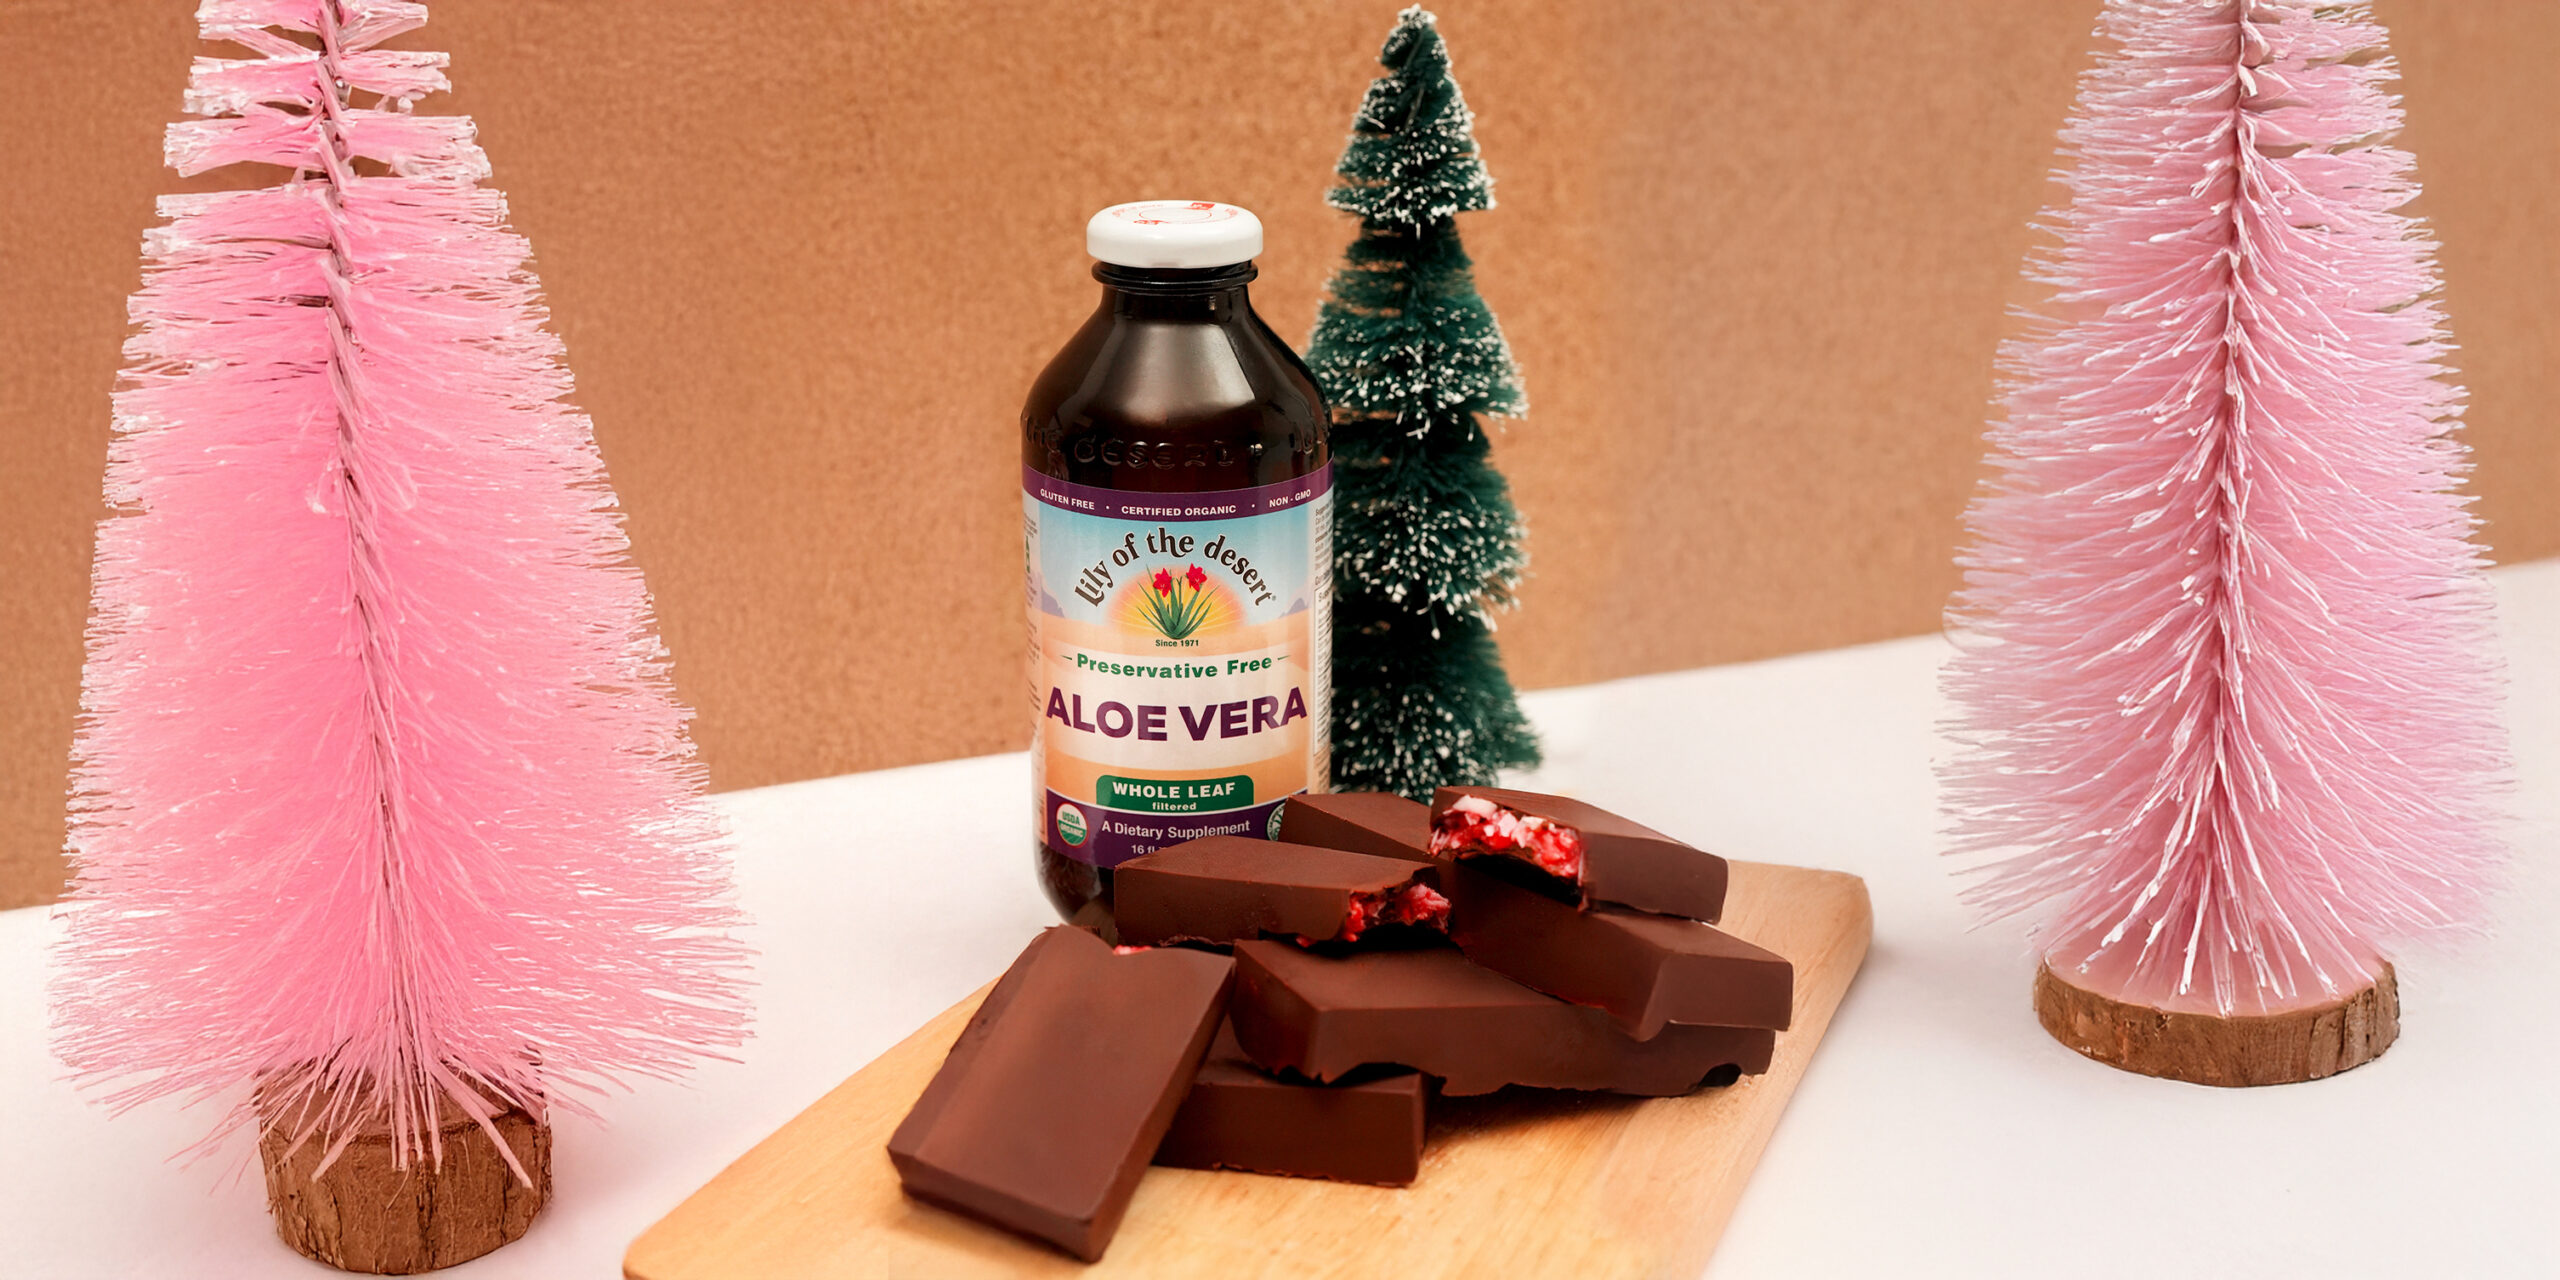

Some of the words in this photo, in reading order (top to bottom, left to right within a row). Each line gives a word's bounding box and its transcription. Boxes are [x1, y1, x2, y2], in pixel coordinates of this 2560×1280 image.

[1040, 488, 1069, 505] GLUTEN
[1071, 498, 1095, 510] FREE
[1269, 496, 1289, 508] NON
[1294, 489, 1312, 502] GMO
[1121, 505, 1182, 517] CERTIFIED
[1184, 505, 1237, 517] ORGANIC
[1112, 532, 1140, 567] of
[1146, 527, 1195, 558] the
[1155, 639, 1178, 648] Since
[1180, 639, 1200, 648] 1971
[1076, 652, 1218, 679] Preservative
[1226, 655, 1273, 676] Free
[1046, 686, 1168, 742] ALOE
[1178, 686, 1308, 742] VERA
[1112, 781, 1181, 799] WHOLE
[1187, 781, 1236, 799] LEAF
[1152, 802, 1197, 811] filtered
[1062, 811, 1081, 826] USDA
[1101, 820, 1112, 833] A
[1114, 822, 1164, 841] Dietary
[1167, 820, 1251, 840] Supplement
[1131, 844, 1145, 855] 16
